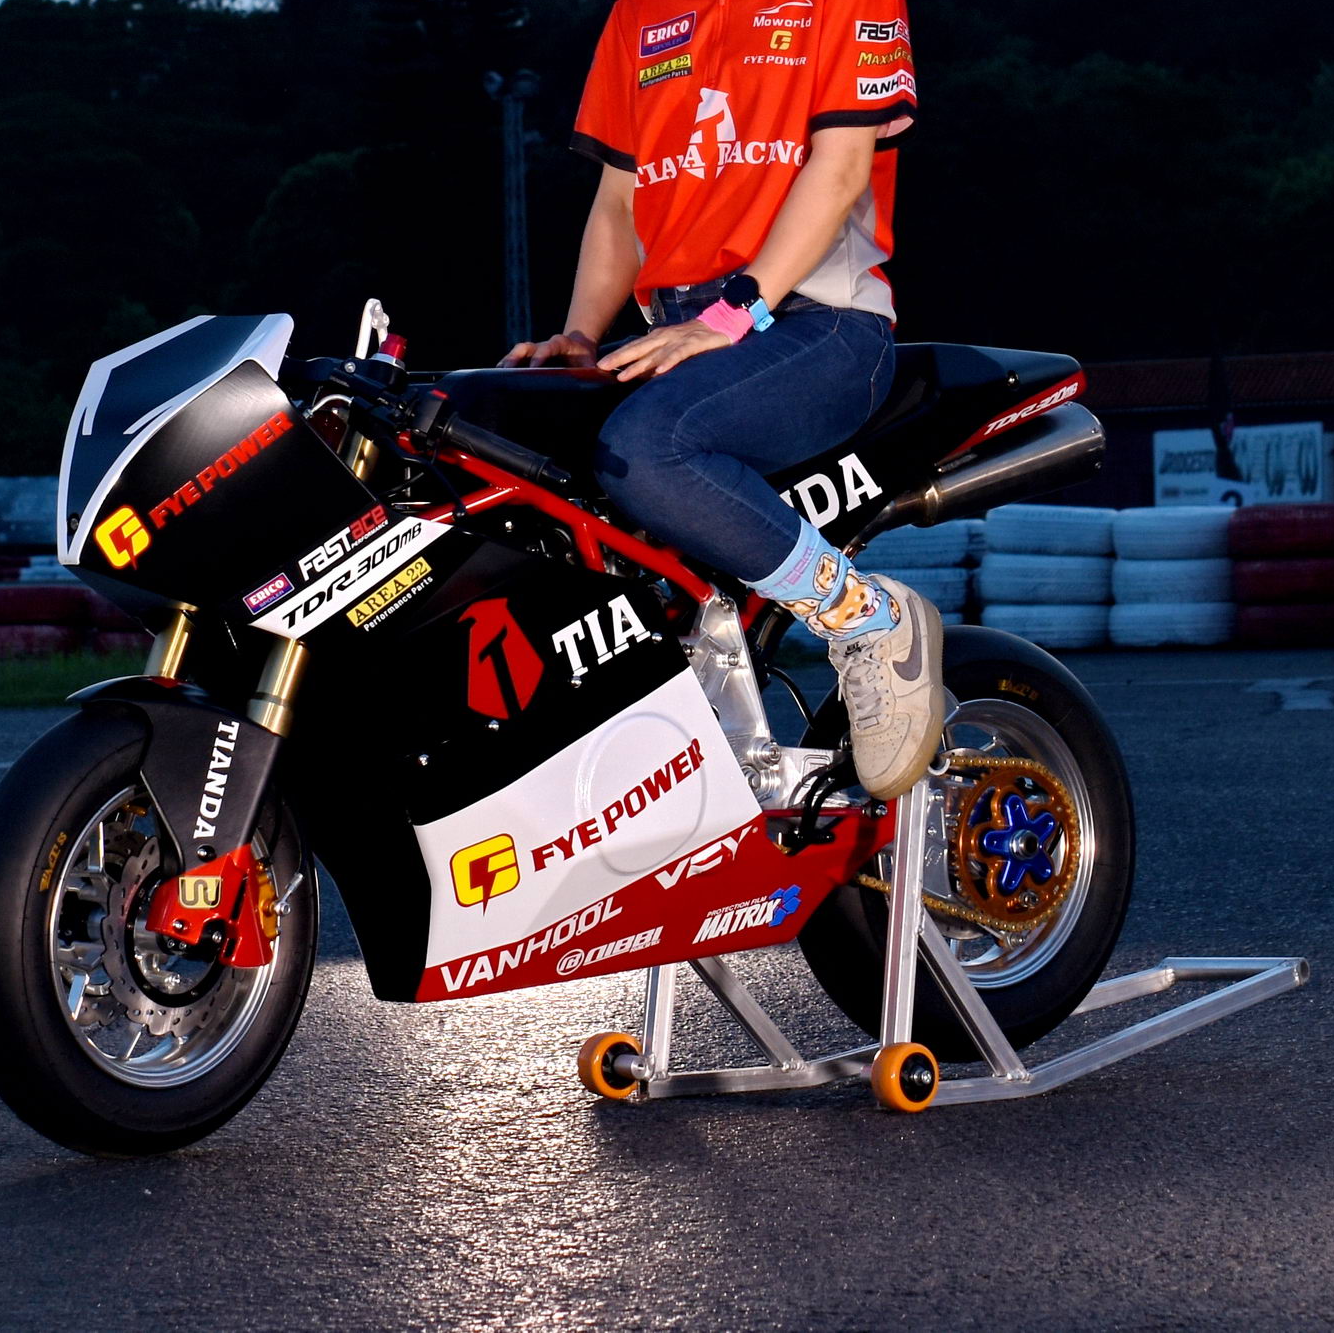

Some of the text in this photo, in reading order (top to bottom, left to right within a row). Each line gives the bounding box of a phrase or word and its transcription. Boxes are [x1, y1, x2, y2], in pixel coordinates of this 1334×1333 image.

[647, 20, 690, 44] ERICO
[753, 15, 812, 28] Moworld
[641, 56, 689, 81] AREA 22
[671, 69, 688, 78] Parts
[743, 55, 807, 66] FYE POWER
[148, 410, 294, 529] FYE POWER
[249, 579, 285, 606] ERICO
[354, 561, 428, 624] AREA 22
[363, 576, 434, 632] Performance Parts
[552, 593, 651, 677] TIA
[193, 720, 240, 839] TIANDA
[531, 738, 705, 872] FYE POWER
[692, 898, 781, 944] MATRIX
[706, 895, 768, 918] PROTECTION FILM
[440, 896, 623, 992] VANHOOL
